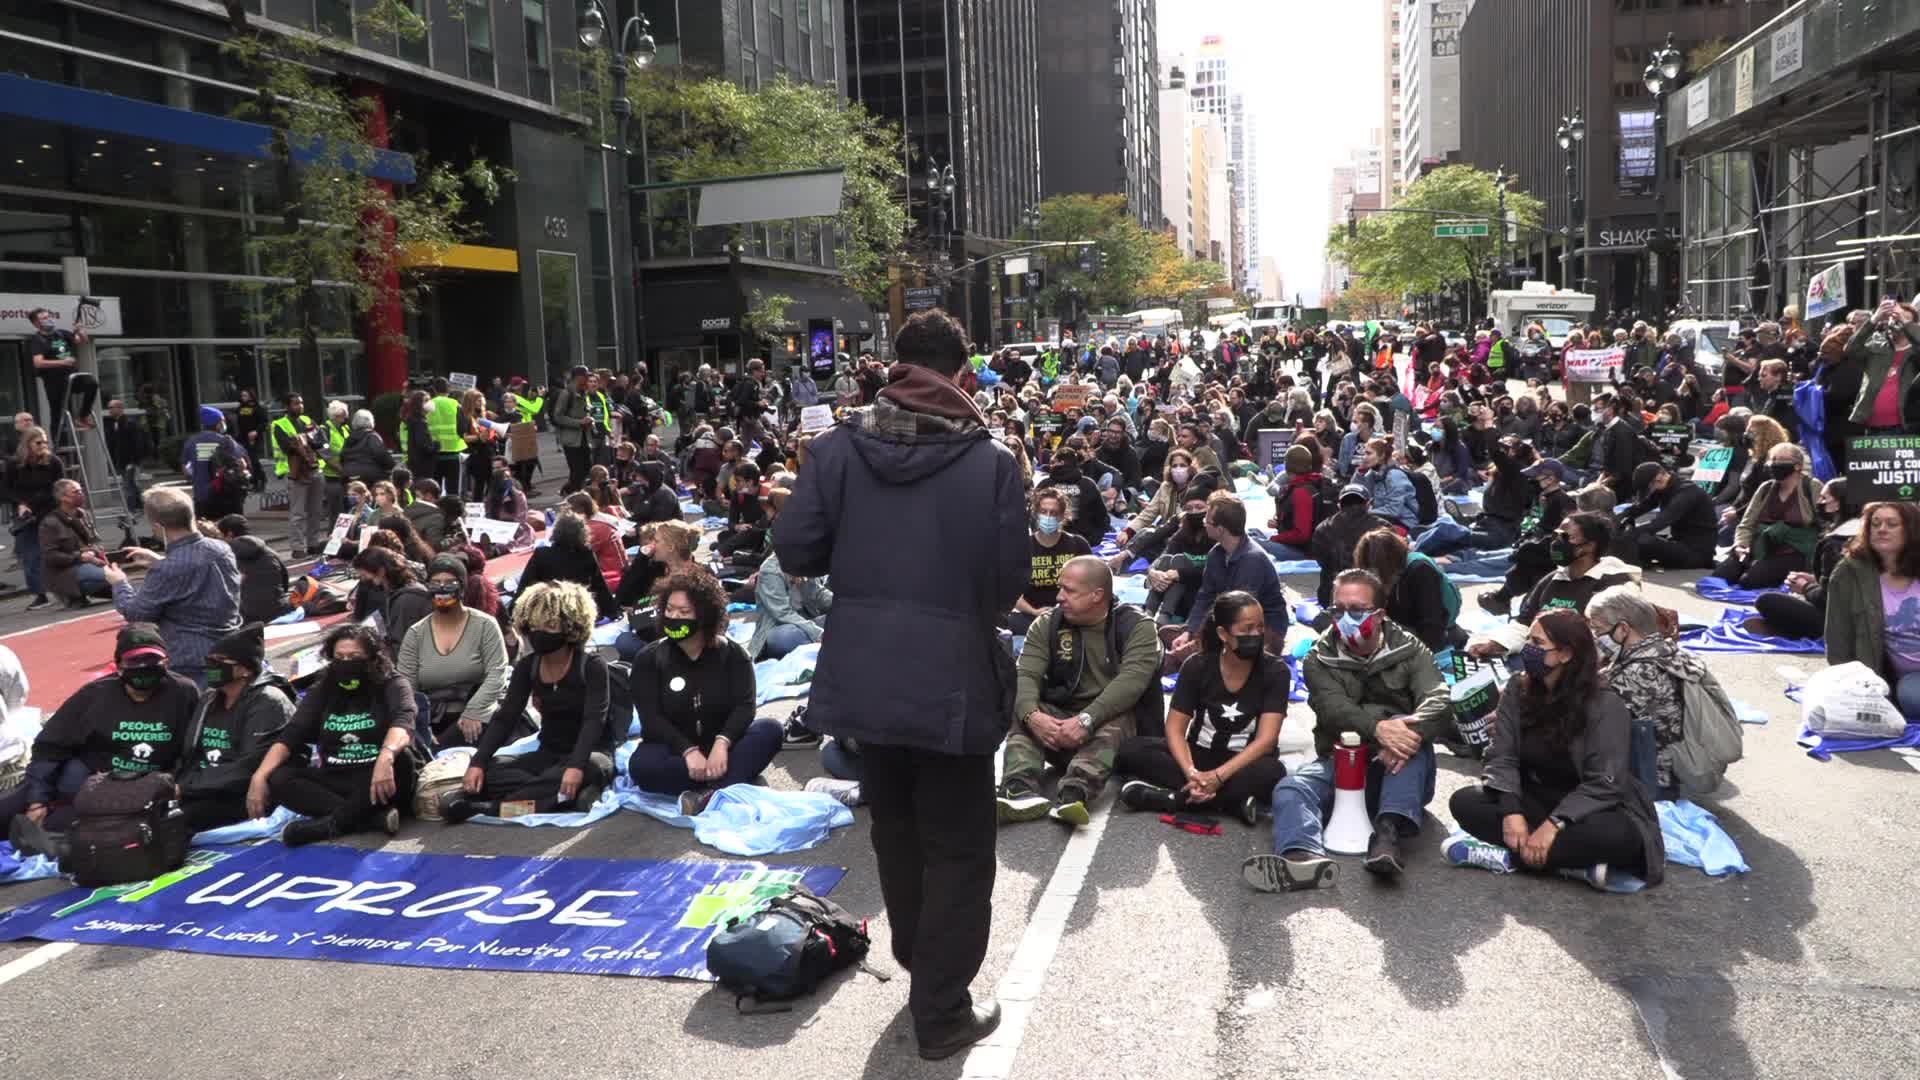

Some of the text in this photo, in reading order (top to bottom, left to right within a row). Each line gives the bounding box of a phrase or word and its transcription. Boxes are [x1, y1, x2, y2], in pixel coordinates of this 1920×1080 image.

[1599, 228, 1657, 246] SHAKE
[1535, 302, 1568, 310] verizon
[1895, 449, 1915, 459] FOR
[1848, 460, 1892, 471] CLIMATE
[1894, 460, 1902, 469] &
[1872, 470, 1920, 485] JUSTI
[1031, 556, 1053, 567] REEN
[323, 719, 376, 731] POWERED
[111, 731, 173, 741] POWERED
[186, 871, 639, 927] UPROSE
[167, 921, 203, 937] En
[206, 925, 277, 944] Lucha
[286, 931, 311, 946] Y
[312, 934, 413, 951] Siempre
[474, 939, 571, 959] Nuestra
[582, 945, 662, 962] Gente
